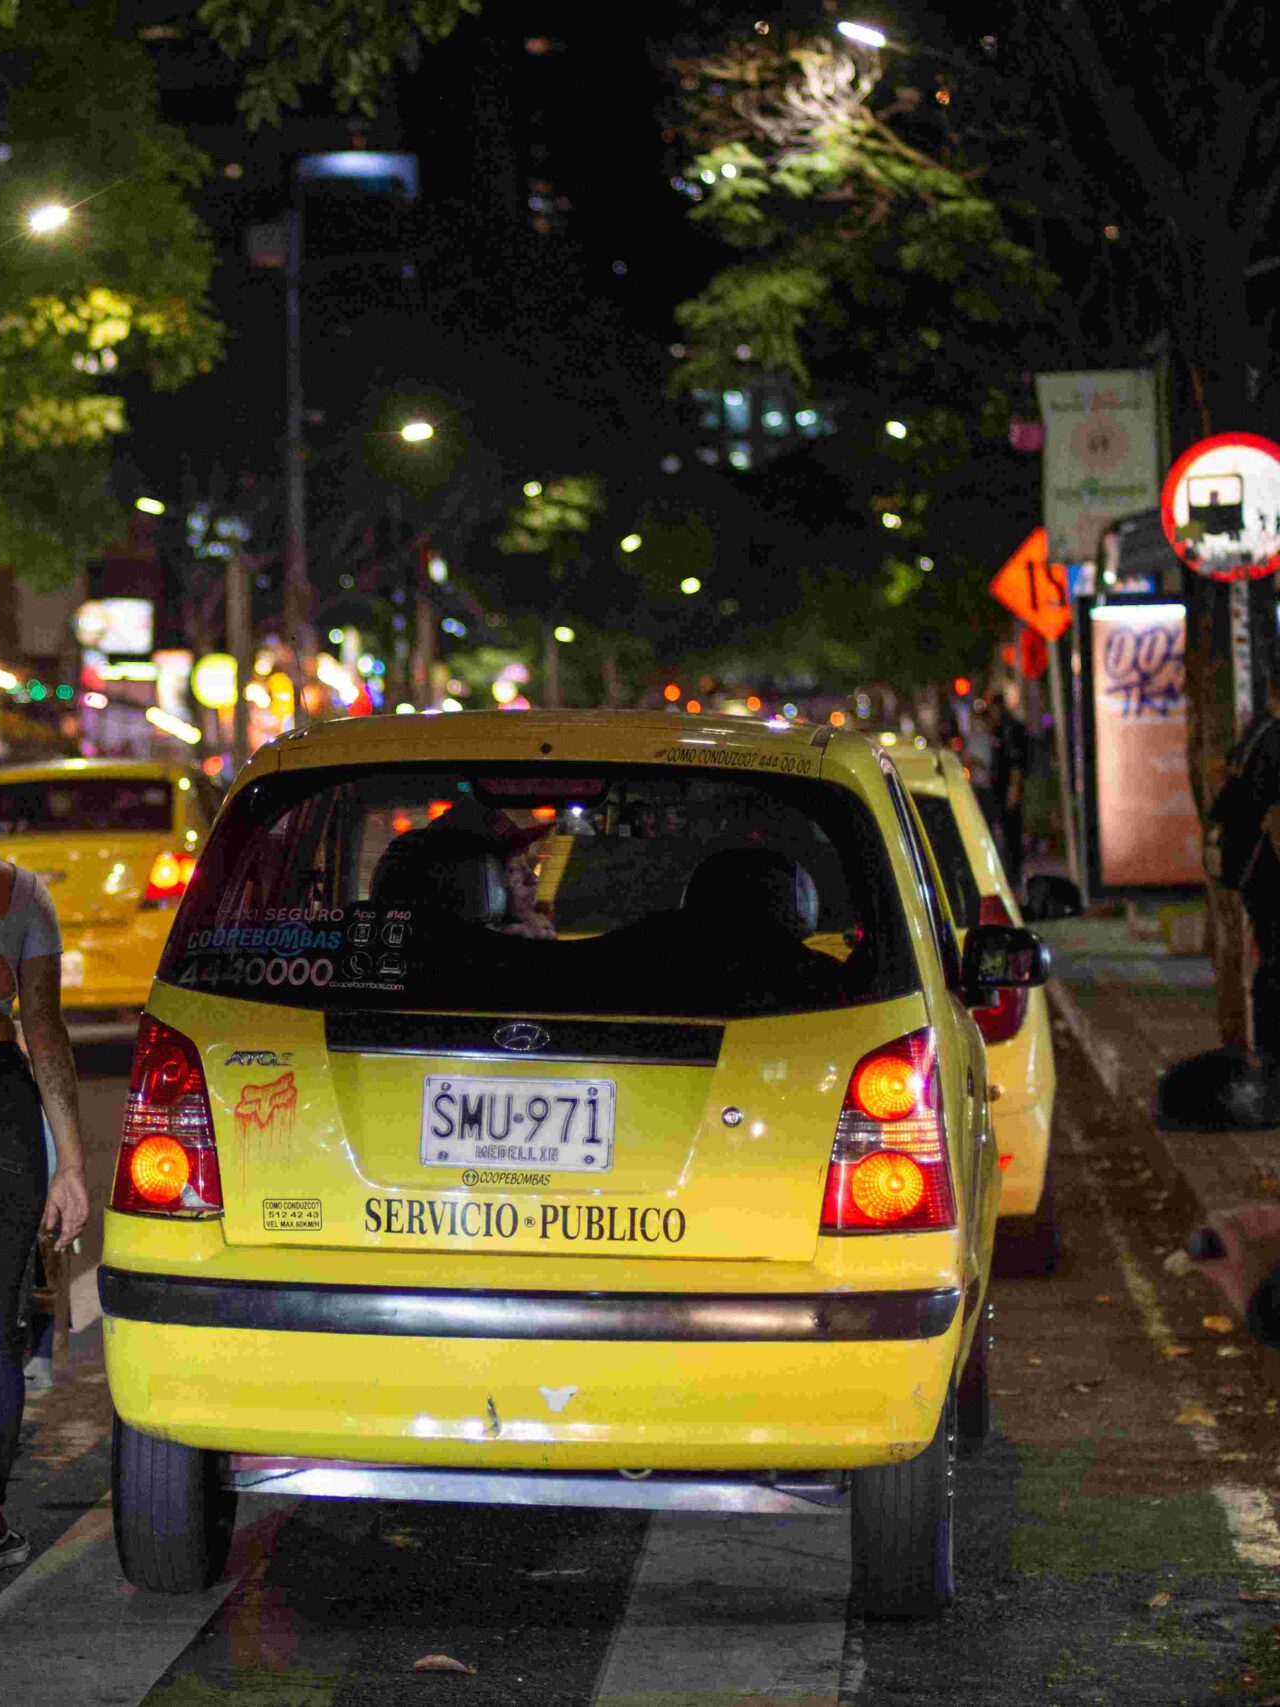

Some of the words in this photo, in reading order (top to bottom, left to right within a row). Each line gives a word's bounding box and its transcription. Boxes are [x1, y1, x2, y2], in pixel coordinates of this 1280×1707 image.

[666, 747, 697, 763] COMO
[698, 749, 758, 767] CONDUZCO?
[780, 756, 793, 772] 00
[796, 759, 811, 774] 00
[264, 907, 344, 922] SEGURO
[353, 908, 376, 920] App
[386, 911, 411, 921] #140
[187, 926, 342, 950] COOPEBOMBAS
[178, 957, 333, 988] 4440000
[475, 1145, 559, 1162] MEDELLIN
[479, 1171, 552, 1186] COOPEBOMBAS
[364, 1197, 519, 1239] SERVICIO
[539, 1204, 687, 1243] PUBLICO
